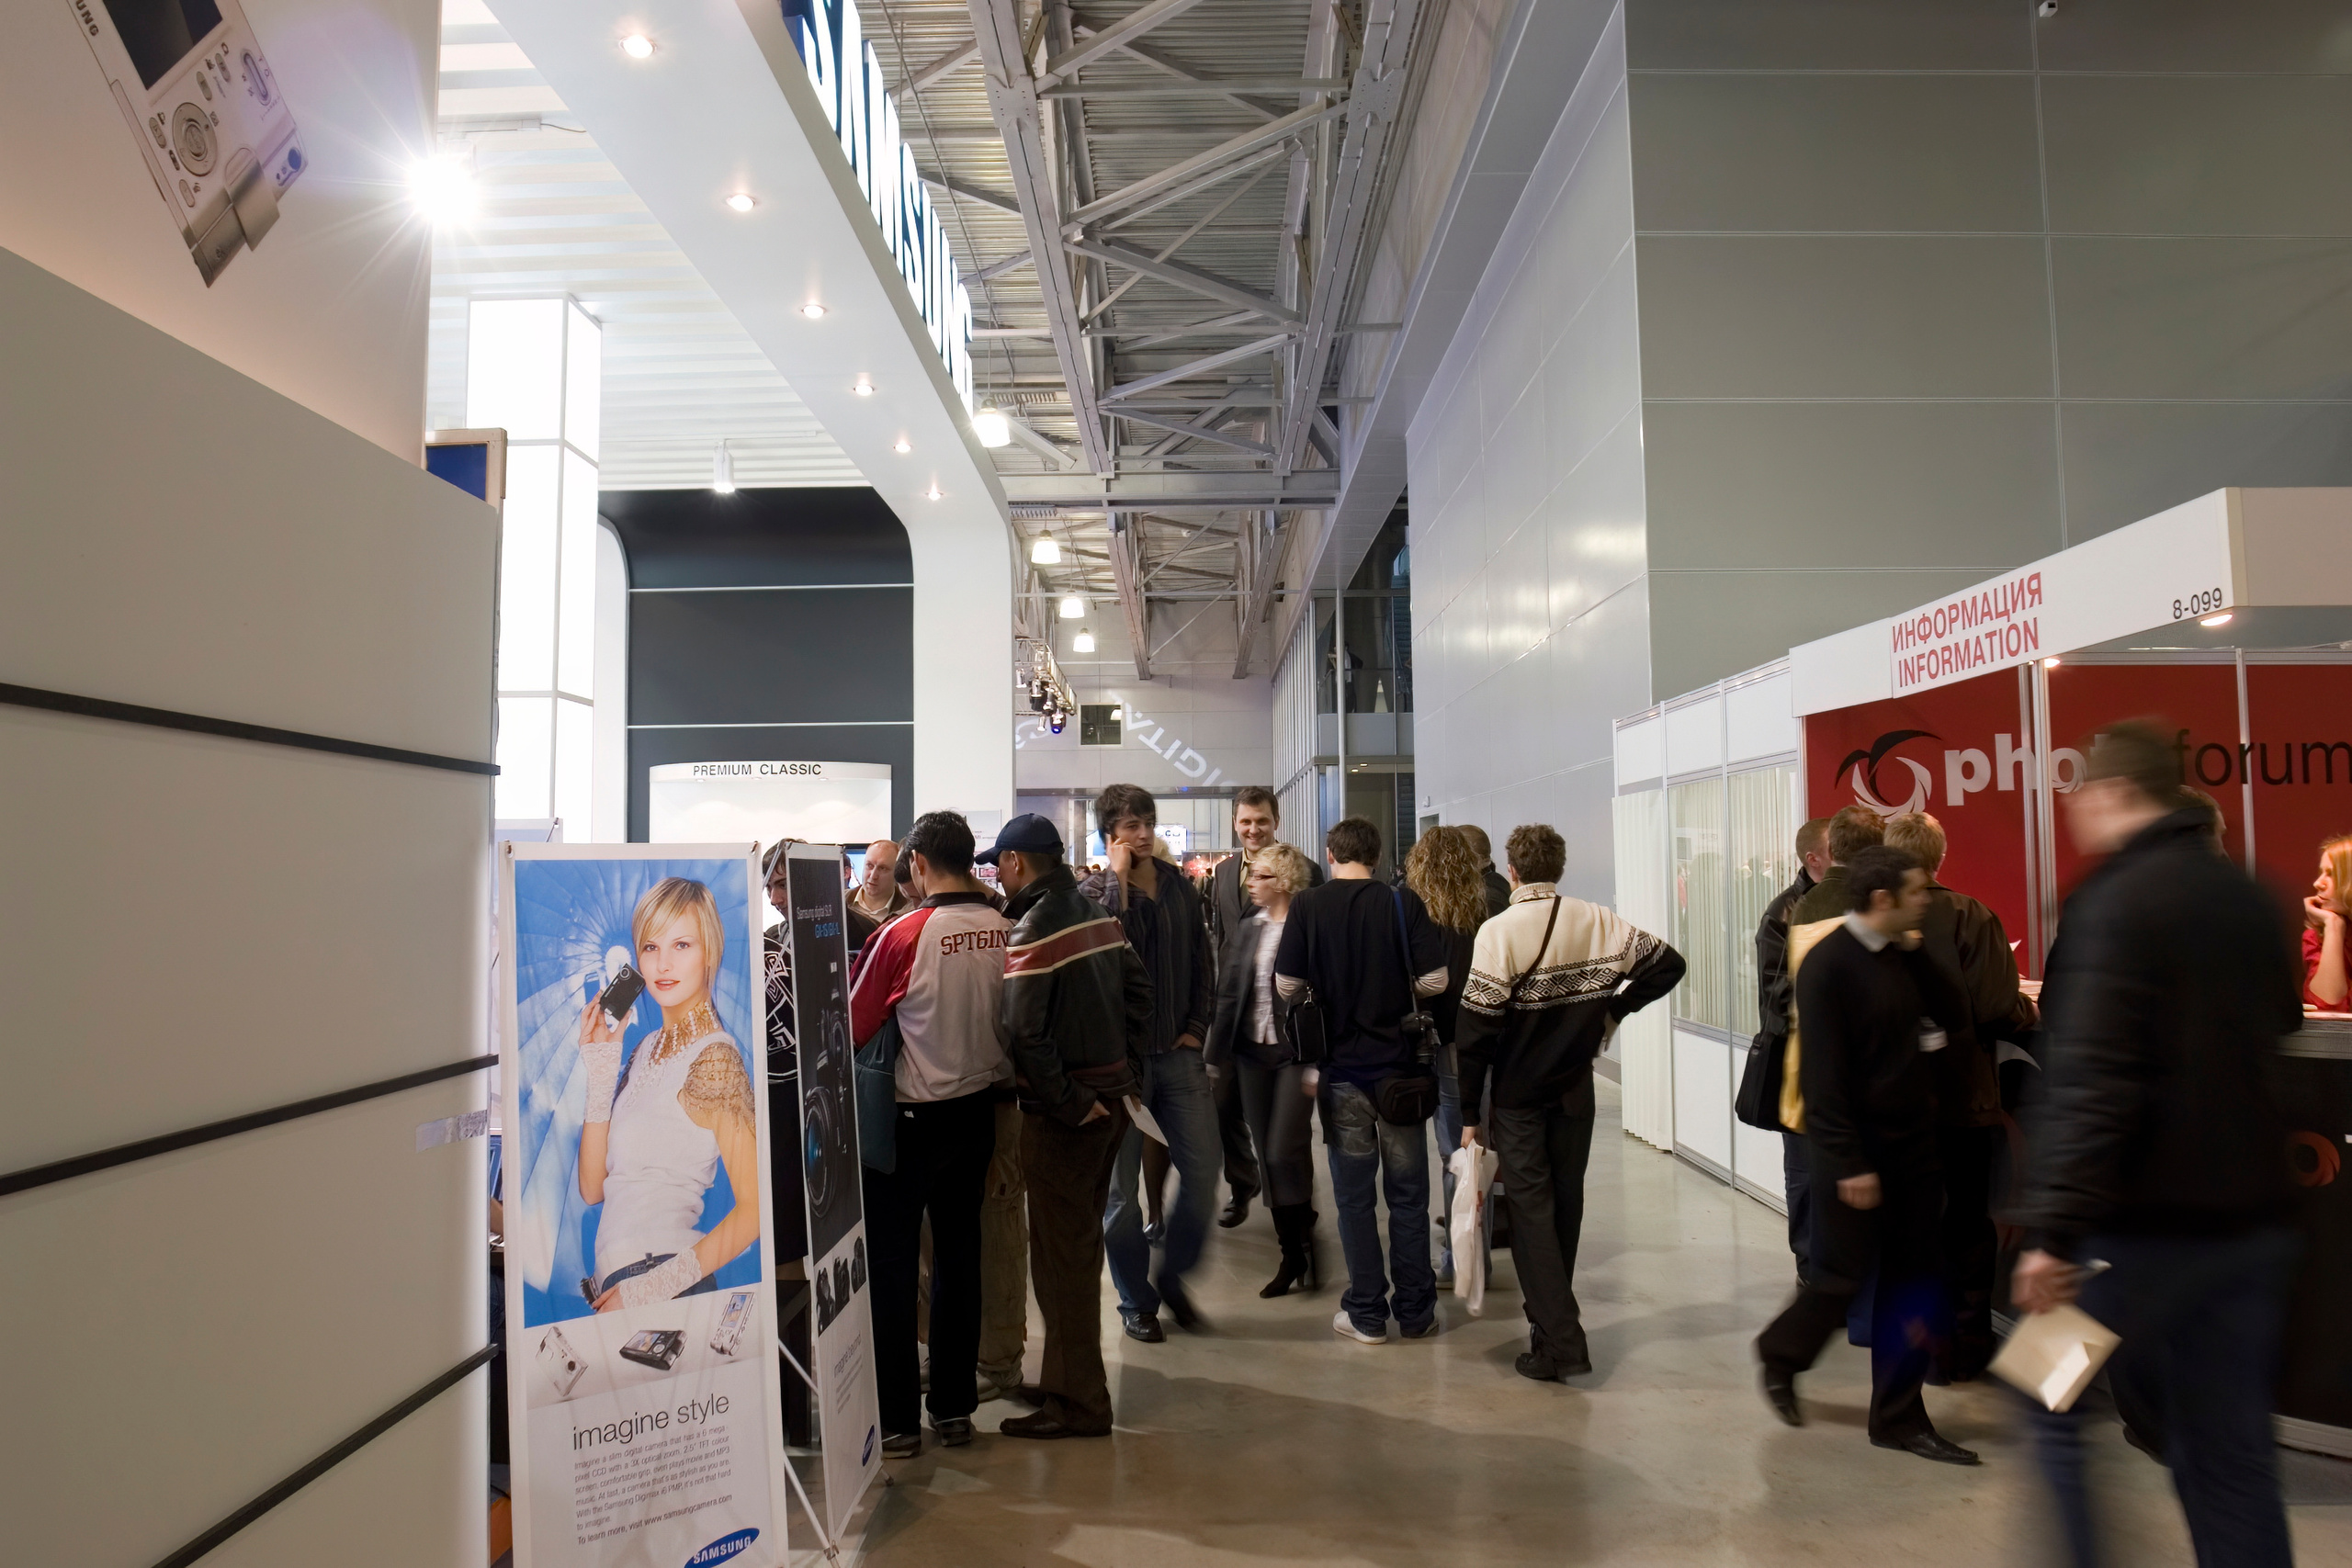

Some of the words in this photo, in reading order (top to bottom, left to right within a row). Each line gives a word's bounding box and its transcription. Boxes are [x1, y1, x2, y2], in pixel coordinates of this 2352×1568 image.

[1893, 571, 2042, 653] ИНФОРМАЦИЯ
[2173, 588, 2222, 620] 8-099
[1898, 616, 2040, 688] INFORMATION
[1108, 690, 1240, 787] IGITA
[693, 764, 752, 776] PREMIUM
[760, 763, 822, 775] CLASSIC
[573, 1411, 669, 1450] imagine
[677, 1393, 729, 1425] style
[574, 1458, 600, 1470] Imagine
[608, 1452, 621, 1461] slim
[624, 1446, 642, 1457] digital
[644, 1440, 667, 1451] camera
[669, 1436, 681, 1445] that
[592, 1467, 606, 1477] CCD
[608, 1464, 621, 1472] with
[641, 1452, 662, 1464] optical
[711, 1435, 729, 1445] colour
[600, 1472, 637, 1487] comfortable
[653, 1463, 667, 1473] even
[668, 1460, 684, 1470] plays
[684, 1454, 703, 1463] movie
[704, 1450, 715, 1460] and
[716, 1446, 729, 1455] MP3
[576, 1508, 591, 1518] With
[604, 1497, 634, 1510] Samsung
[635, 1490, 659, 1502] Digimax
[705, 1472, 716, 1483] that
[717, 1469, 730, 1478] hard
[627, 1481, 650, 1492] camera
[678, 1467, 697, 1478] stylish
[707, 1461, 718, 1472] you
[587, 1531, 605, 1541] learn
[628, 1519, 643, 1530] visit
[693, 1536, 752, 1565] SAMSUNG
